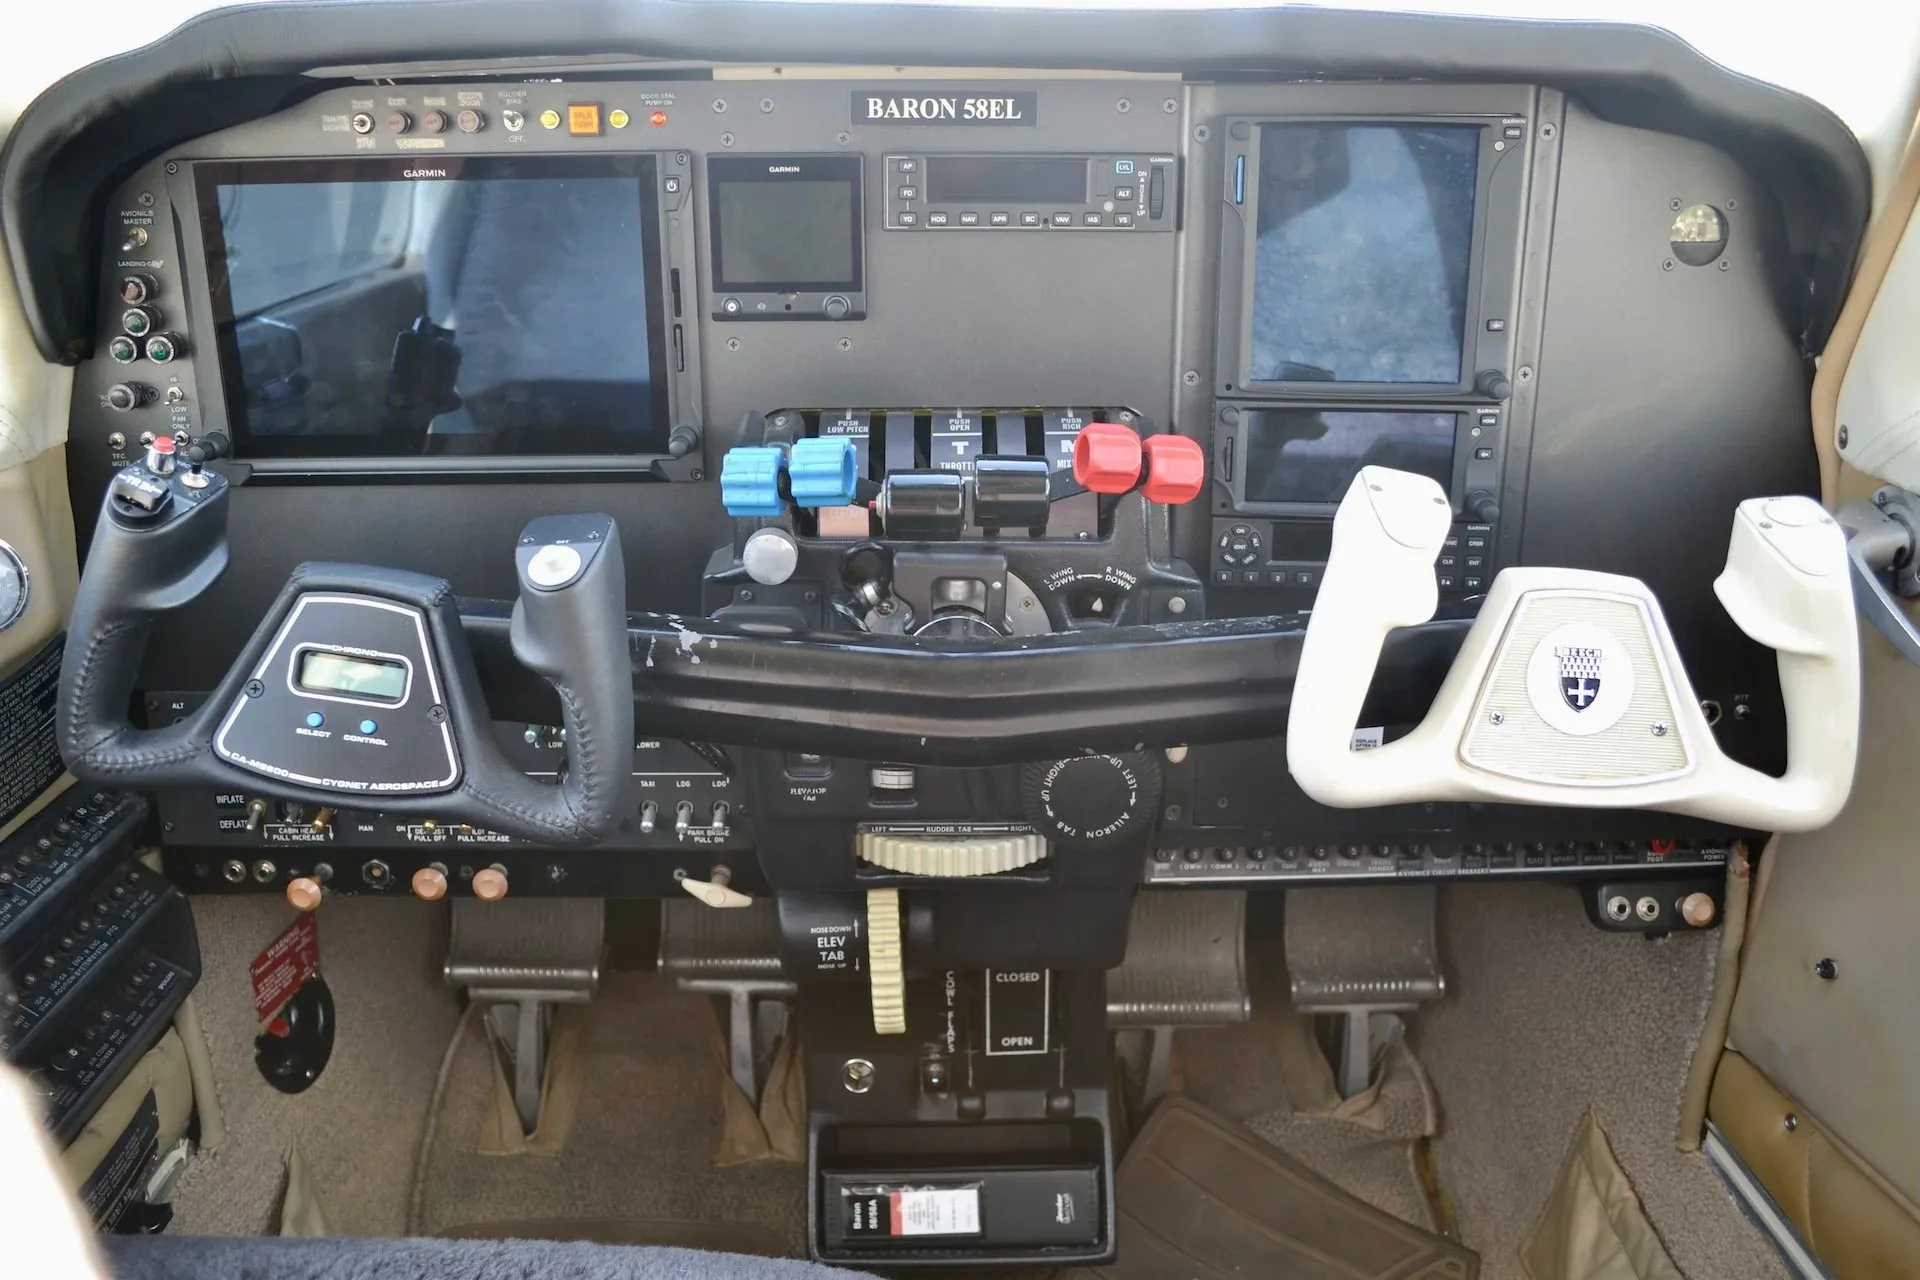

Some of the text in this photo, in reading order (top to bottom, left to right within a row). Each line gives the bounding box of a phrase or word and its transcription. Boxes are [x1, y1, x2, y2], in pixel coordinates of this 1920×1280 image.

[866, 98, 1022, 120] BARON 58EL
[403, 170, 446, 178] GARMIN
[120, 210, 154, 218] AVIONICS
[118, 260, 146, 268] LANDING
[952, 441, 969, 455] T
[1050, 566, 1074, 581] WING
[1105, 566, 1138, 585] R WING
[1048, 574, 1076, 592] DOWN
[1105, 574, 1133, 591] DOWN
[331, 644, 378, 657] CHRONO
[172, 702, 185, 710] ALT
[296, 727, 332, 738] SELECT
[343, 734, 388, 747] CONTROL
[1109, 756, 1138, 790] LEFT UP
[321, 778, 369, 791] CYGNET
[370, 780, 440, 792] AEROSPACE
[676, 780, 691, 788] LDG
[712, 780, 727, 788] LDG
[1040, 760, 1066, 802] RIGHT UP
[790, 787, 827, 796] ELEVATOR
[216, 794, 245, 804] INFLATE
[1056, 811, 1130, 838] AILERON TAB
[291, 834, 325, 842] INCREASE
[477, 835, 510, 843] INCREASE
[1398, 869, 1430, 877] AVIONICS
[1457, 868, 1489, 876] BREAKERS
[828, 925, 852, 933] DOWN
[817, 936, 846, 948] ELEV
[819, 950, 845, 962] TAB
[996, 972, 1040, 983] CLOSED
[54, 974, 77, 996] POSITION
[946, 971, 955, 1006] COWL
[1001, 1036, 1033, 1047] OPEN
[852, 1202, 862, 1230] Baron
